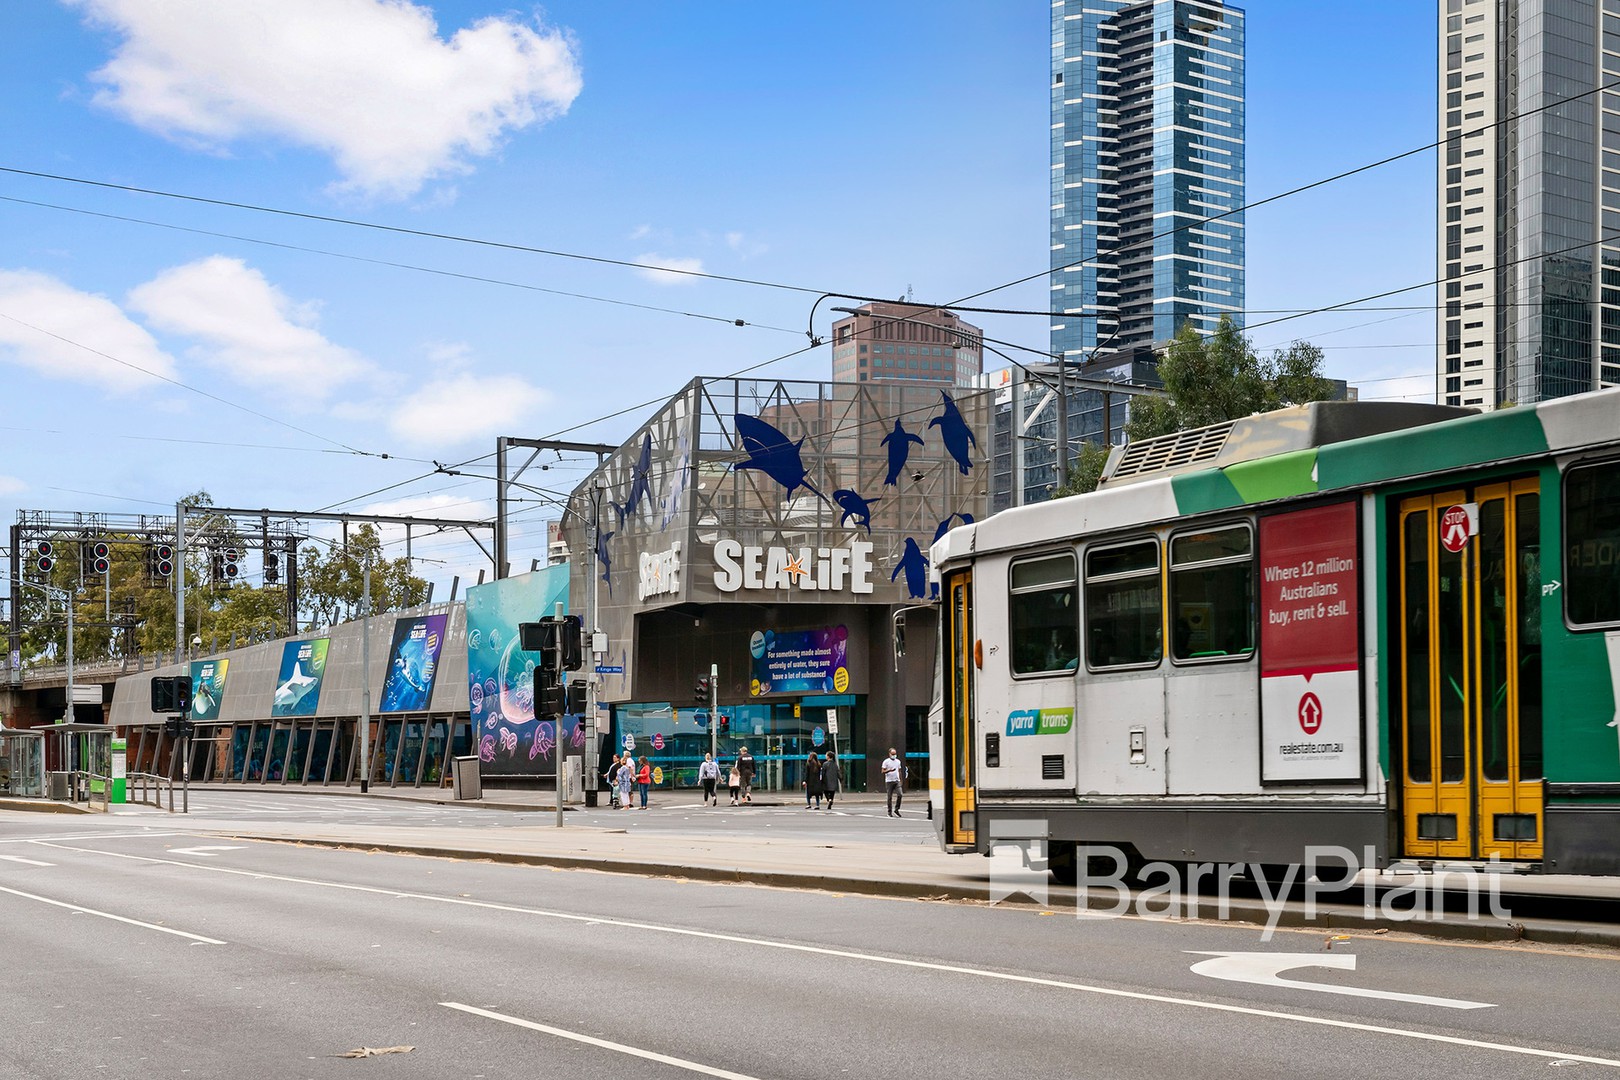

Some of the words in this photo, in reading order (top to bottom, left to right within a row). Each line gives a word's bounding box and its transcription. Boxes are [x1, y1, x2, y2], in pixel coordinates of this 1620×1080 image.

[1445, 511, 1466, 525] STOP
[713, 539, 790, 592] SEA
[1264, 566, 1300, 582] Where
[1301, 561, 1315, 577] 12
[1316, 557, 1354, 575] million
[1280, 581, 1338, 601] Australians
[1269, 609, 1291, 627] buy,
[1293, 605, 1315, 621] rent
[1316, 602, 1326, 618] &
[1327, 600, 1349, 617] sell.
[776, 649, 800, 659] something
[814, 648, 832, 656] almost
[768, 661, 787, 670] entirely
[808, 660, 819, 668] they
[801, 671, 827, 679] substance!
[1010, 716, 1034, 733] yarra
[1041, 713, 1069, 728] trams
[1279, 742, 1344, 755] realestate.com.au
